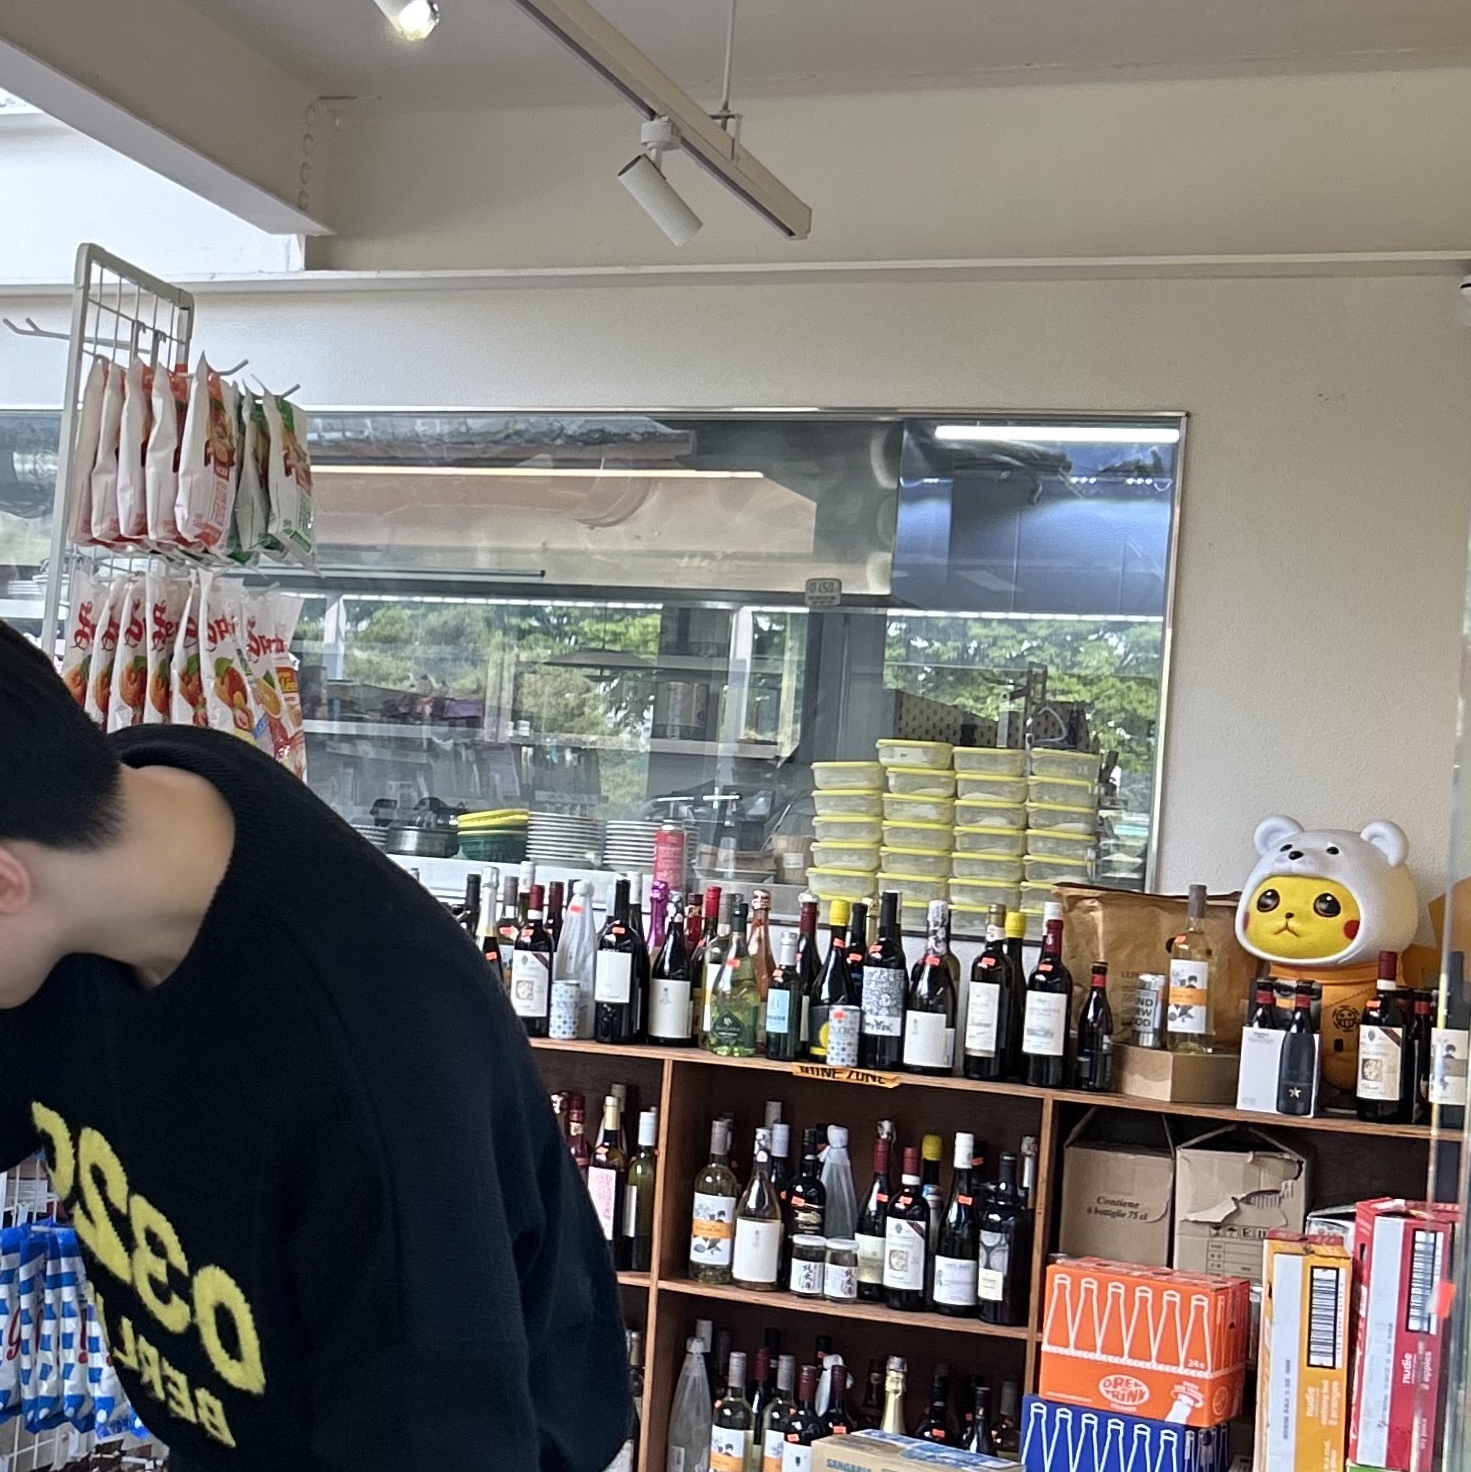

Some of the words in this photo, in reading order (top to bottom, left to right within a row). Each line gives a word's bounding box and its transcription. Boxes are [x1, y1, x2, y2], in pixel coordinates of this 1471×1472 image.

[1094, 1206, 1127, 1220] bottiglie
[1187, 1357, 1206, 1369] 24x
[1402, 1351, 1413, 1386] nudie
